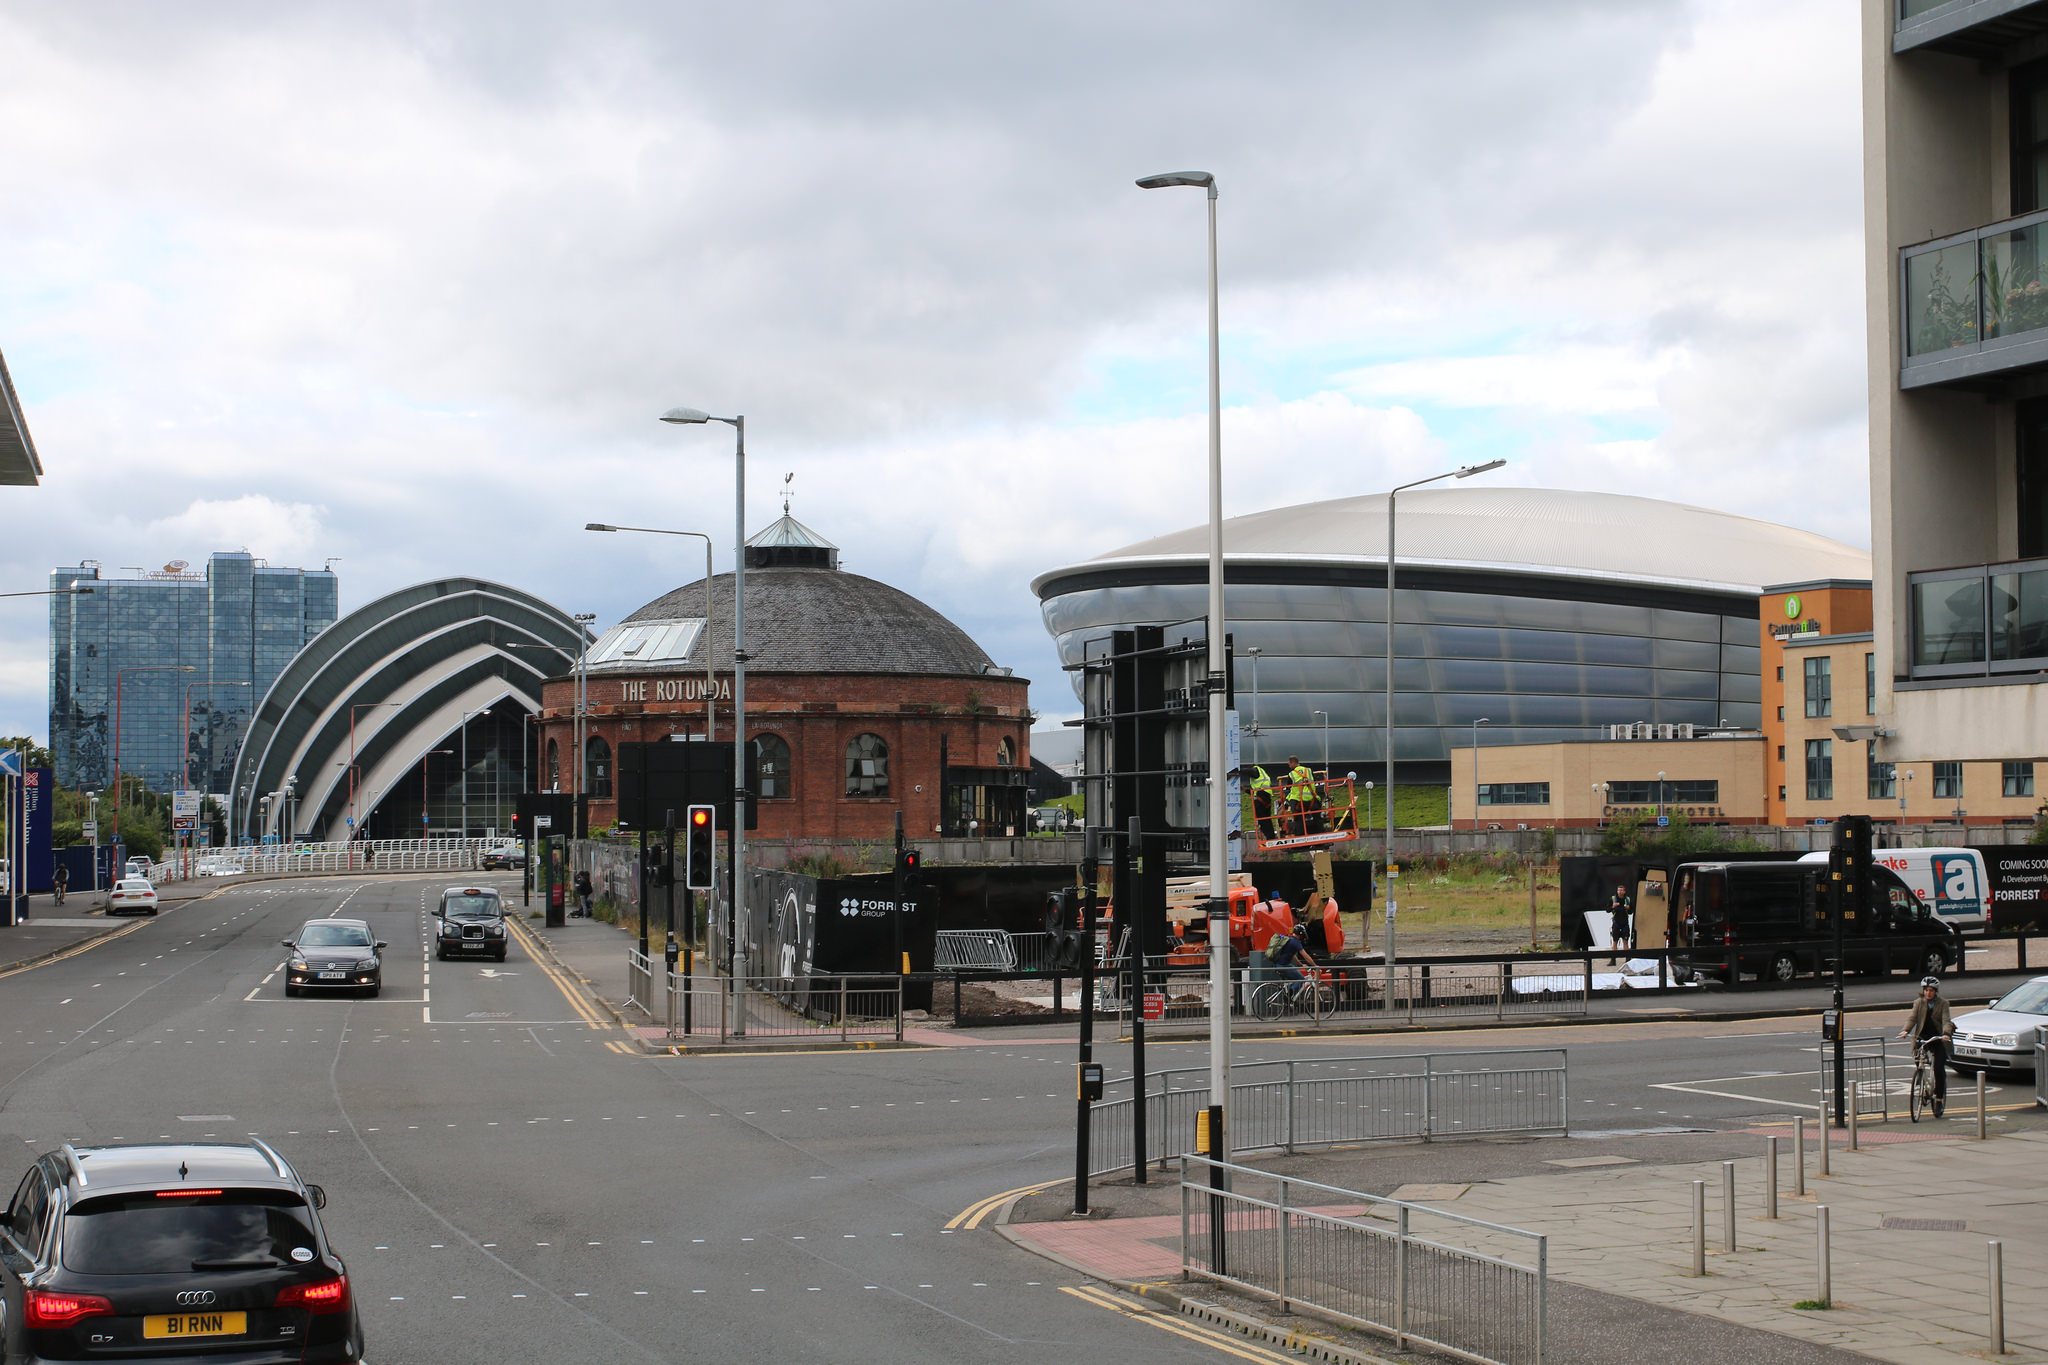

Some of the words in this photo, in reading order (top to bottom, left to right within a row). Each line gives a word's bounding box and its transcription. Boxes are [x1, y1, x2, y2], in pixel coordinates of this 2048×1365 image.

[1768, 618, 1821, 636] Campanile
[621, 681, 647, 701] THE
[656, 680, 731, 701] ROTUNDA
[31, 787, 39, 811] Hilton
[1999, 860, 2031, 870] COMING
[2031, 859, 2048, 869] SOO
[2002, 875, 2007, 883] A
[2007, 875, 2042, 884] Development
[1994, 889, 2040, 902] FORREST
[861, 910, 886, 918] GROUP
[188, 1315, 224, 1333] RNN
[91, 1334, 115, 1344] Q7
